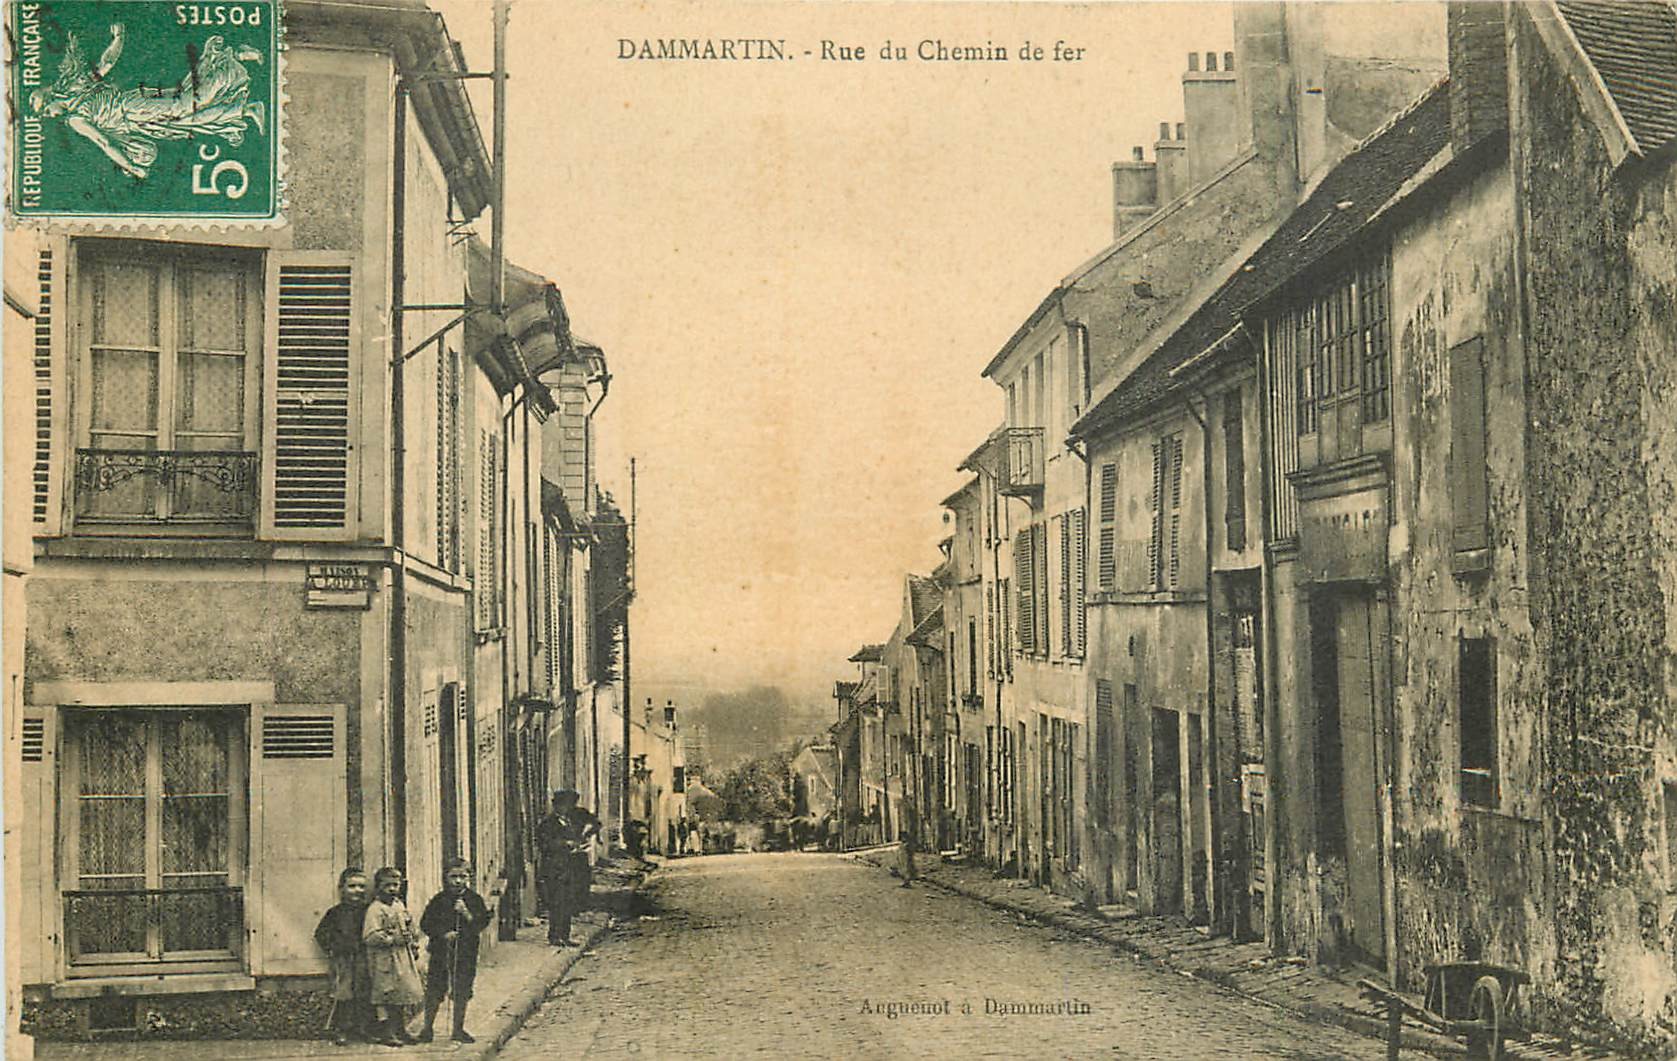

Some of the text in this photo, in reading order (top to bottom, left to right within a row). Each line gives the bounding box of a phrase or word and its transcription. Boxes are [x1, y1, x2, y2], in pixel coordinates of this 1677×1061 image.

[176, 5, 261, 25] POSTES
[22, 3, 44, 208] REPUBLIQUE FRANÇAISE
